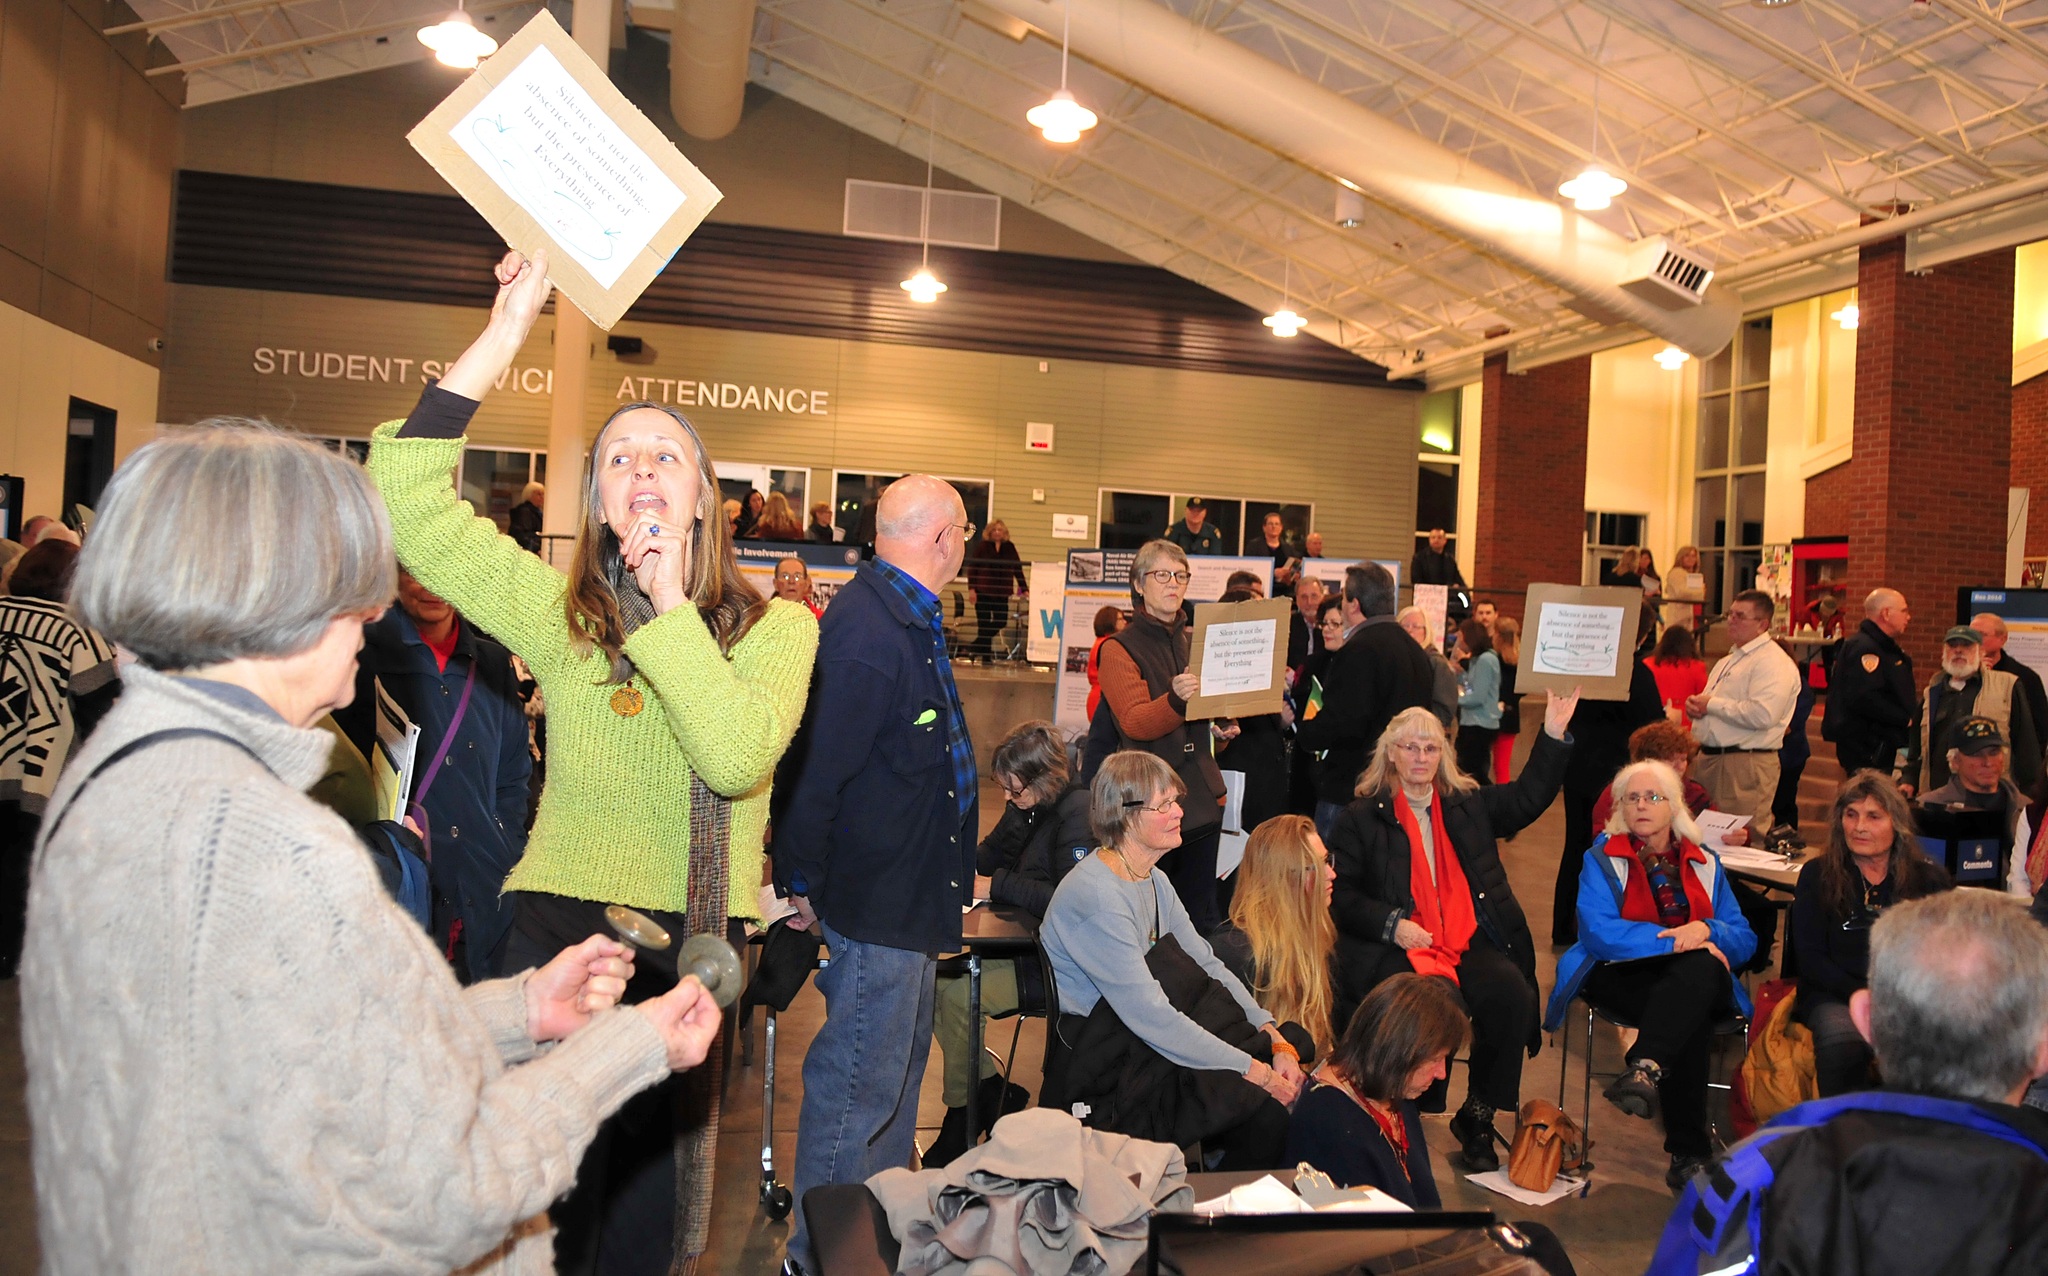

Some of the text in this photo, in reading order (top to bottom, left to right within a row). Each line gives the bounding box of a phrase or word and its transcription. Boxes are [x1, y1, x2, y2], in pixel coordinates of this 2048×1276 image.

[556, 85, 648, 183] Silence is not the
[525, 81, 650, 214] absence of something...
[524, 106, 544, 131] but
[545, 129, 564, 149] the
[563, 152, 615, 202] presence
[617, 204, 633, 217] of
[534, 144, 596, 210] Everything
[253, 347, 413, 384] STUDENT
[616, 376, 829, 415] ATTENDANCE
[744, 548, 798, 558] Involvement
[1552, 630, 1563, 638] but
[1233, 649, 1256, 657] presence
[1565, 642, 1595, 650] Everything
[1224, 660, 1252, 668] Everything
[1963, 860, 1993, 870] Comments
